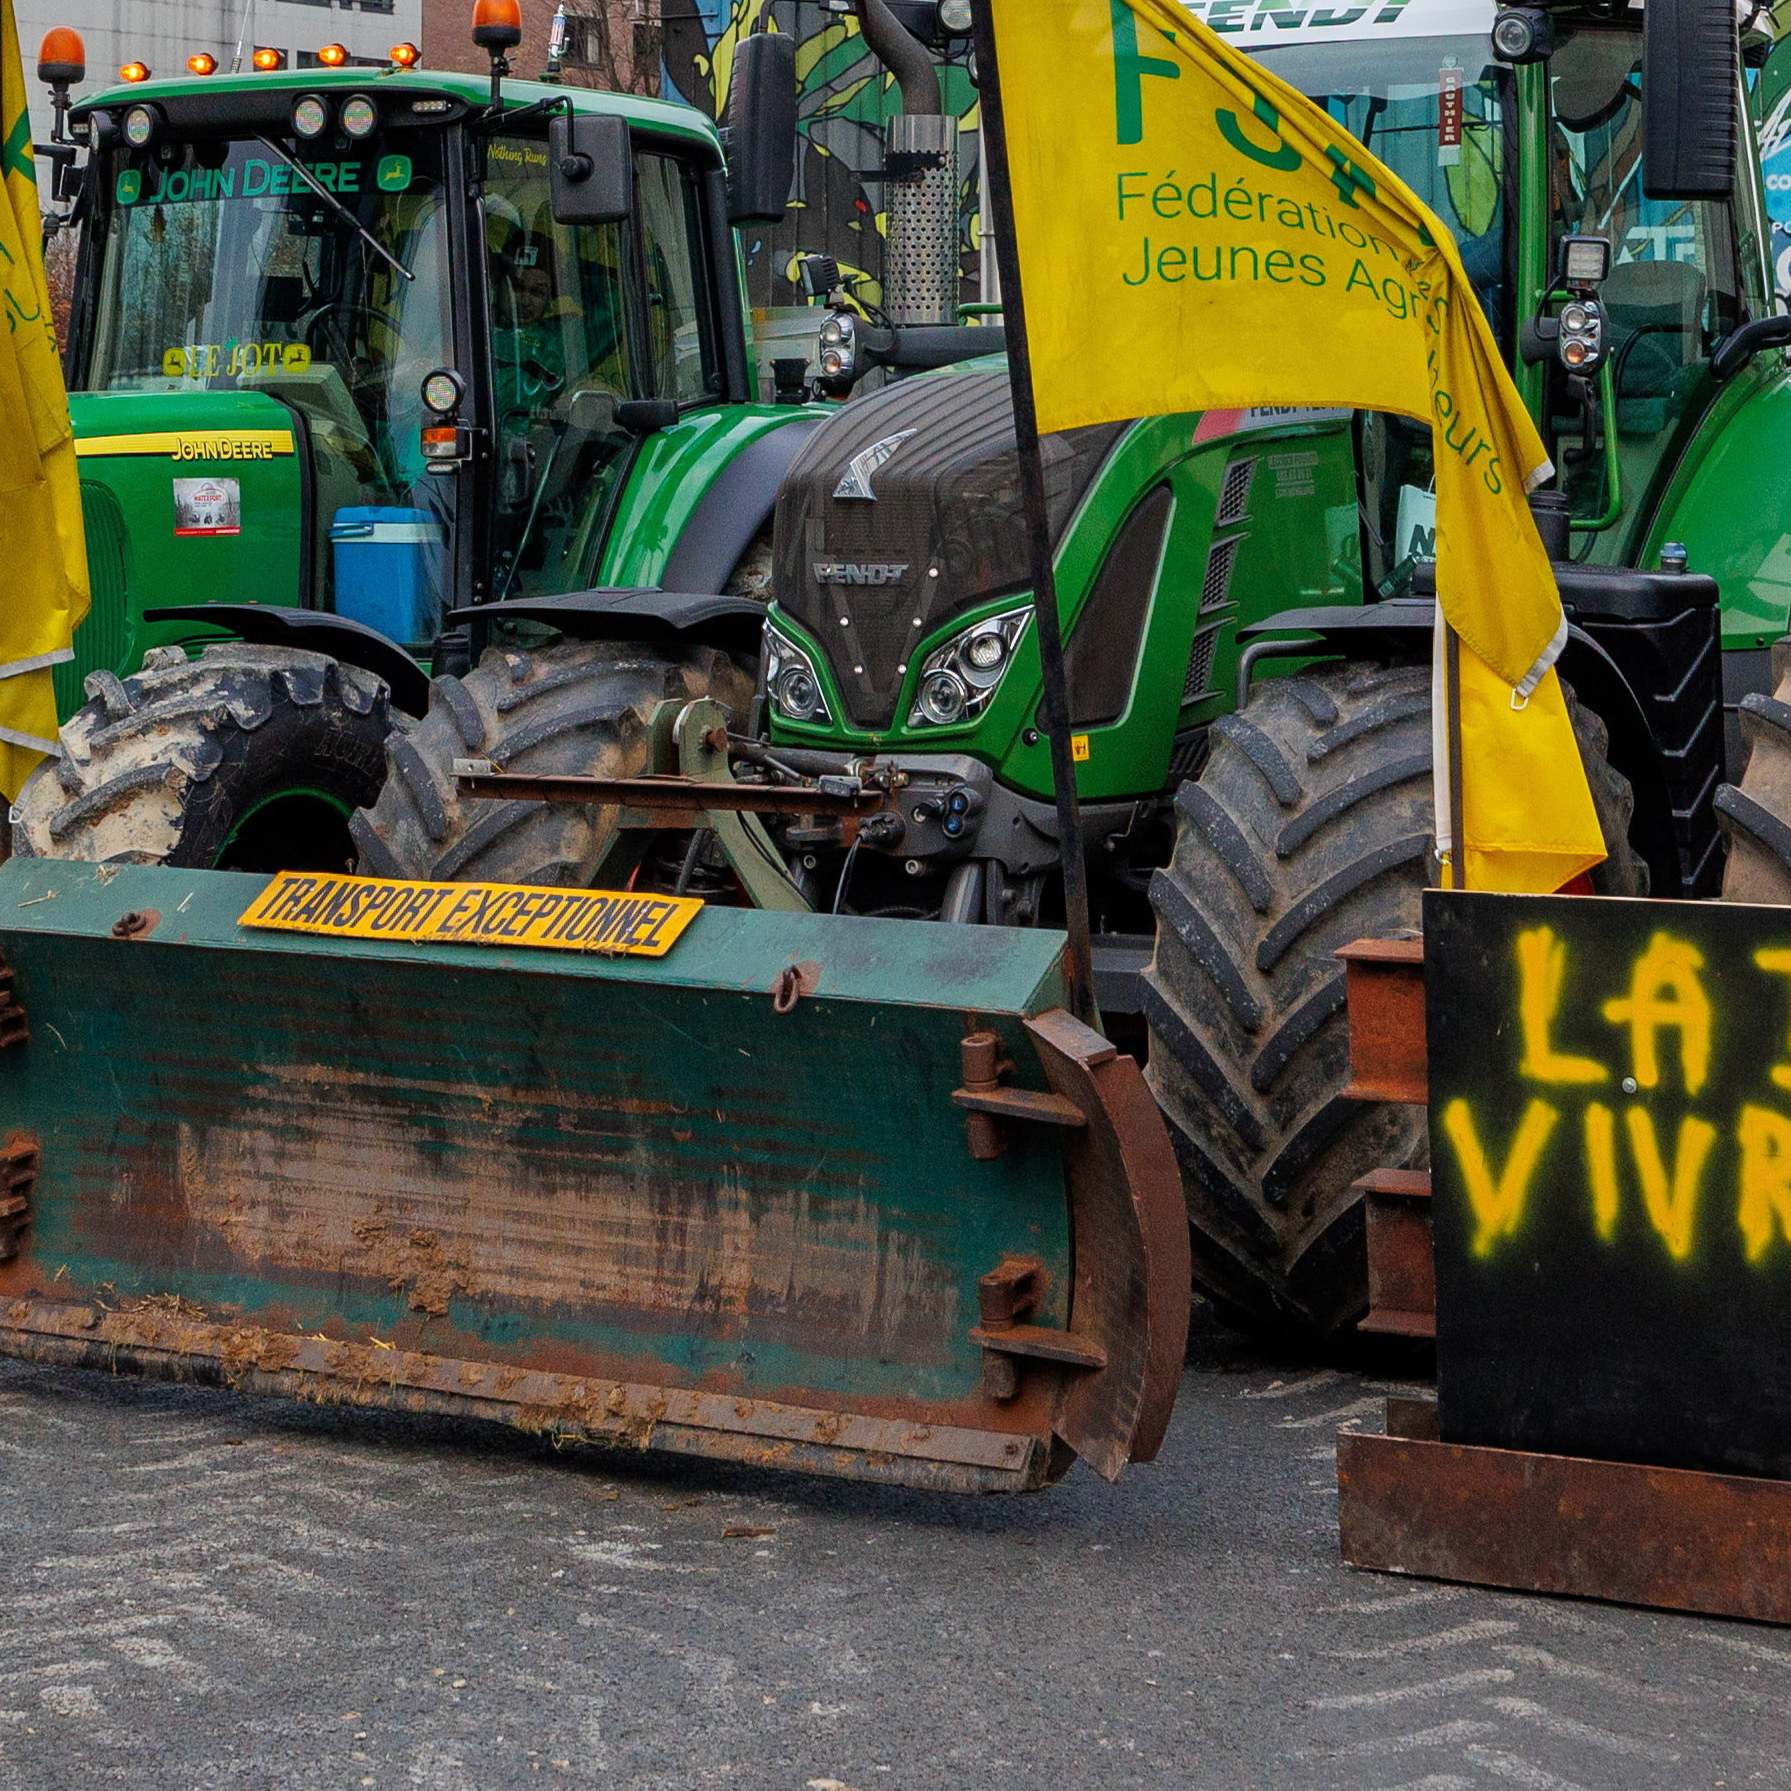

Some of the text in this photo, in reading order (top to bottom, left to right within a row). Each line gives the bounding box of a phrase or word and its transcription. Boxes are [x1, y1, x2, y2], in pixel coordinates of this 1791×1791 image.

[1443, 76, 1456, 142] GAUTHIER
[487, 143, 548, 167] Nothing Runs
[149, 160, 361, 203] JOHN DEERE
[1117, 169, 1400, 264] Fédération
[1122, 236, 1326, 287] Jeunes
[189, 344, 222, 378] LE
[171, 438, 273, 461] JOHN DEERE
[812, 561, 909, 585] FENDT
[257, 877, 679, 948] TRANSPORT EXCEPTIONNEL
